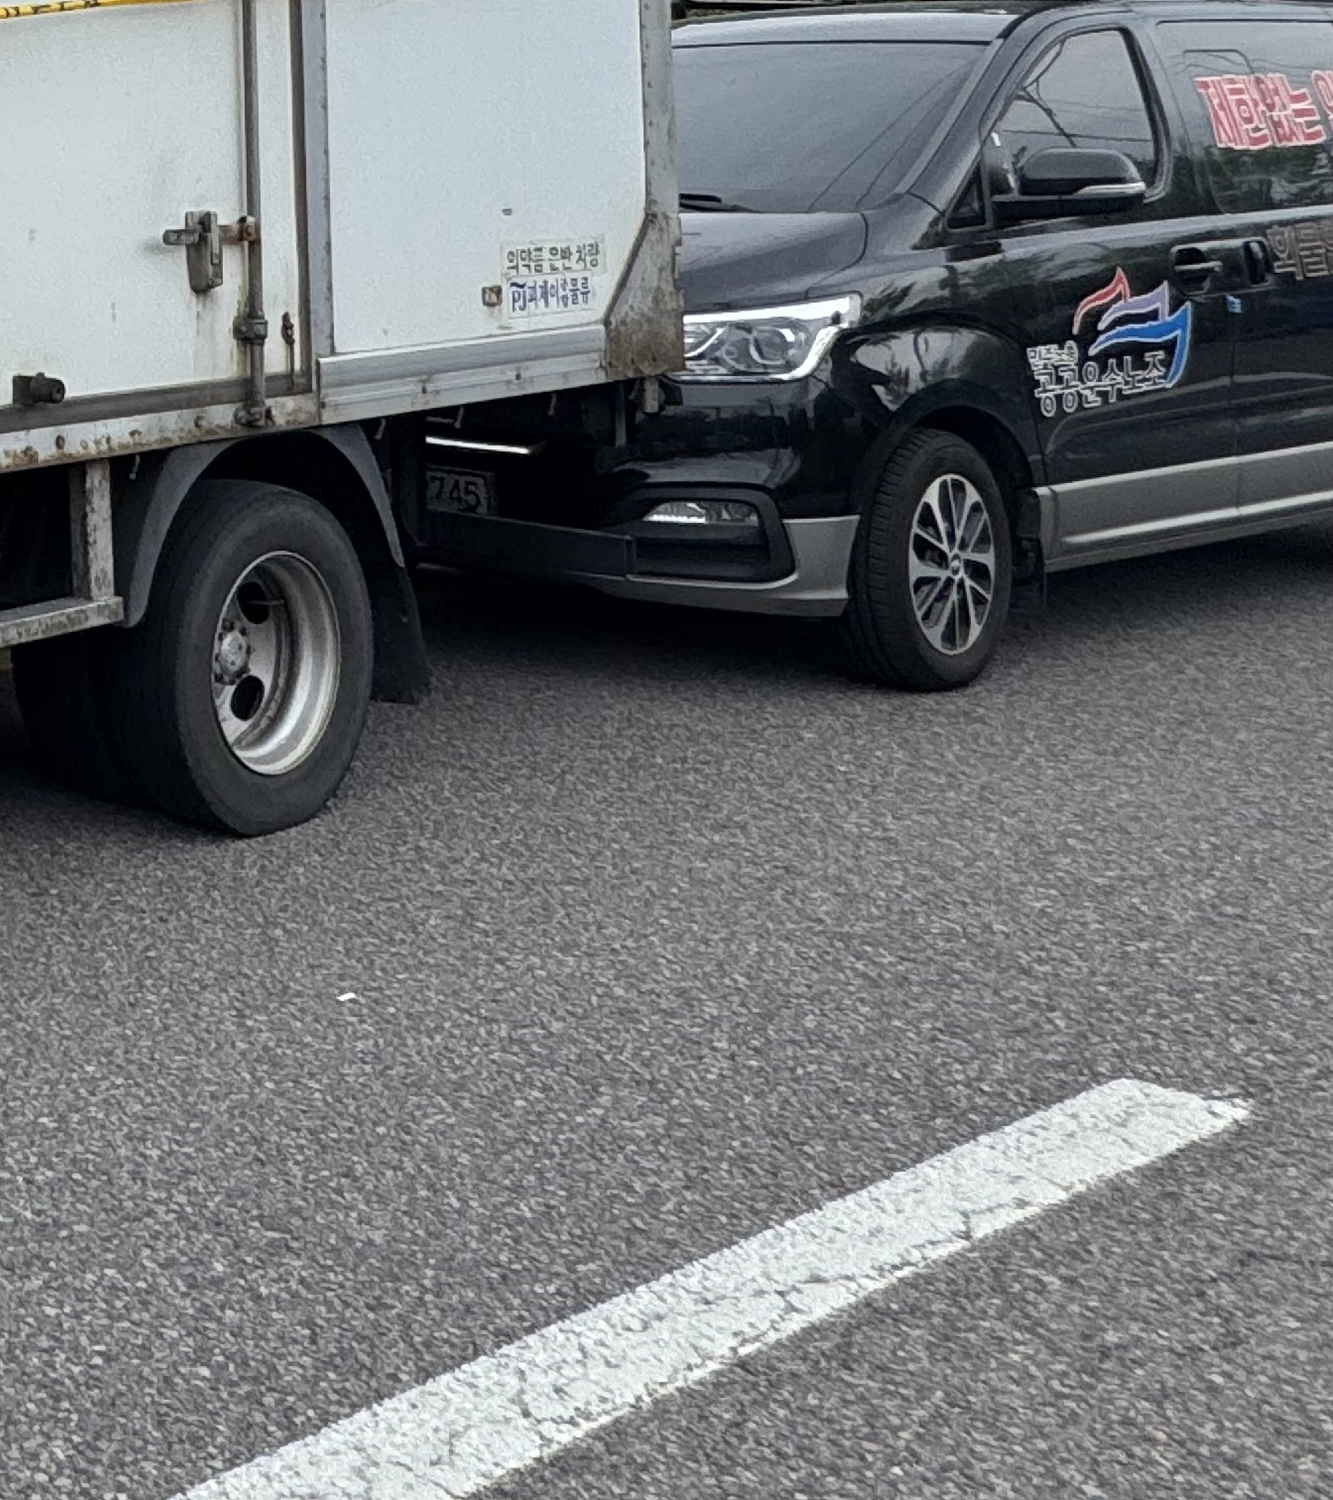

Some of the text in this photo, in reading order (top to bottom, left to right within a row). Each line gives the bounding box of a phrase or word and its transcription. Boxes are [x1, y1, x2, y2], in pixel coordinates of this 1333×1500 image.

[507, 242, 600, 275] 의약품 운반 차량
[1034, 350, 1167, 417] 공공운수노조
